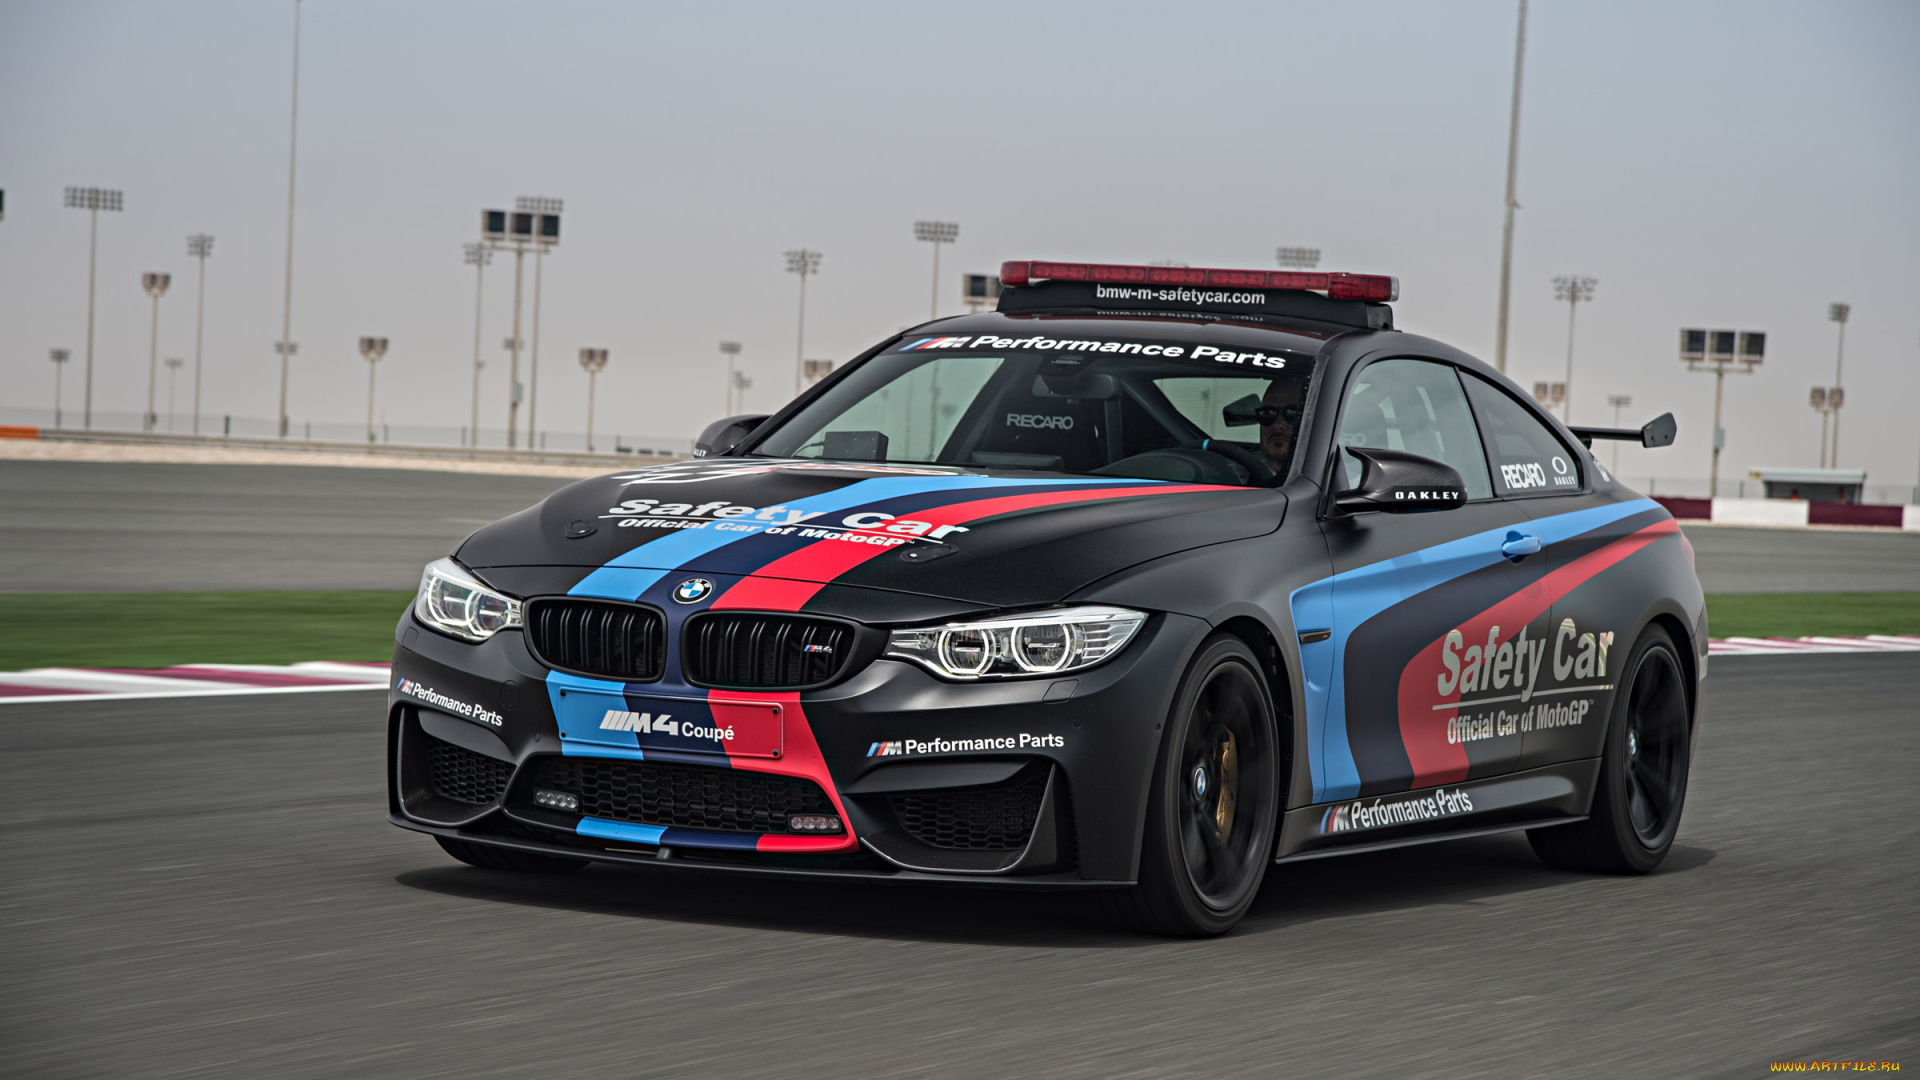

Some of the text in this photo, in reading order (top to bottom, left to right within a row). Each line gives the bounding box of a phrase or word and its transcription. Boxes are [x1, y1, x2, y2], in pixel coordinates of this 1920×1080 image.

[1096, 284, 1265, 305] bmw-m-safetycar.com
[969, 335, 1185, 358] Performance
[1190, 345, 1287, 369] Parts
[1006, 413, 1074, 430] RECARO
[1500, 462, 1547, 489] RECARO
[1554, 476, 1576, 486] OAKLEY
[1395, 491, 1459, 500] OAKLEY
[608, 499, 970, 539] Safety Car
[617, 518, 711, 529] Official
[714, 522, 762, 532] Car
[764, 527, 798, 535] of
[1437, 618, 1615, 702] Safety Car
[411, 682, 473, 716] Performance
[472, 703, 503, 726] Parts
[681, 721, 735, 742] Coupé
[1447, 711, 1495, 745] Official
[1497, 710, 1519, 737] Car
[1521, 705, 1535, 733] of
[905, 737, 1016, 754] Performance
[1019, 733, 1064, 748] Parts
[1351, 798, 1437, 829] Performance
[1436, 788, 1473, 815] Parts
